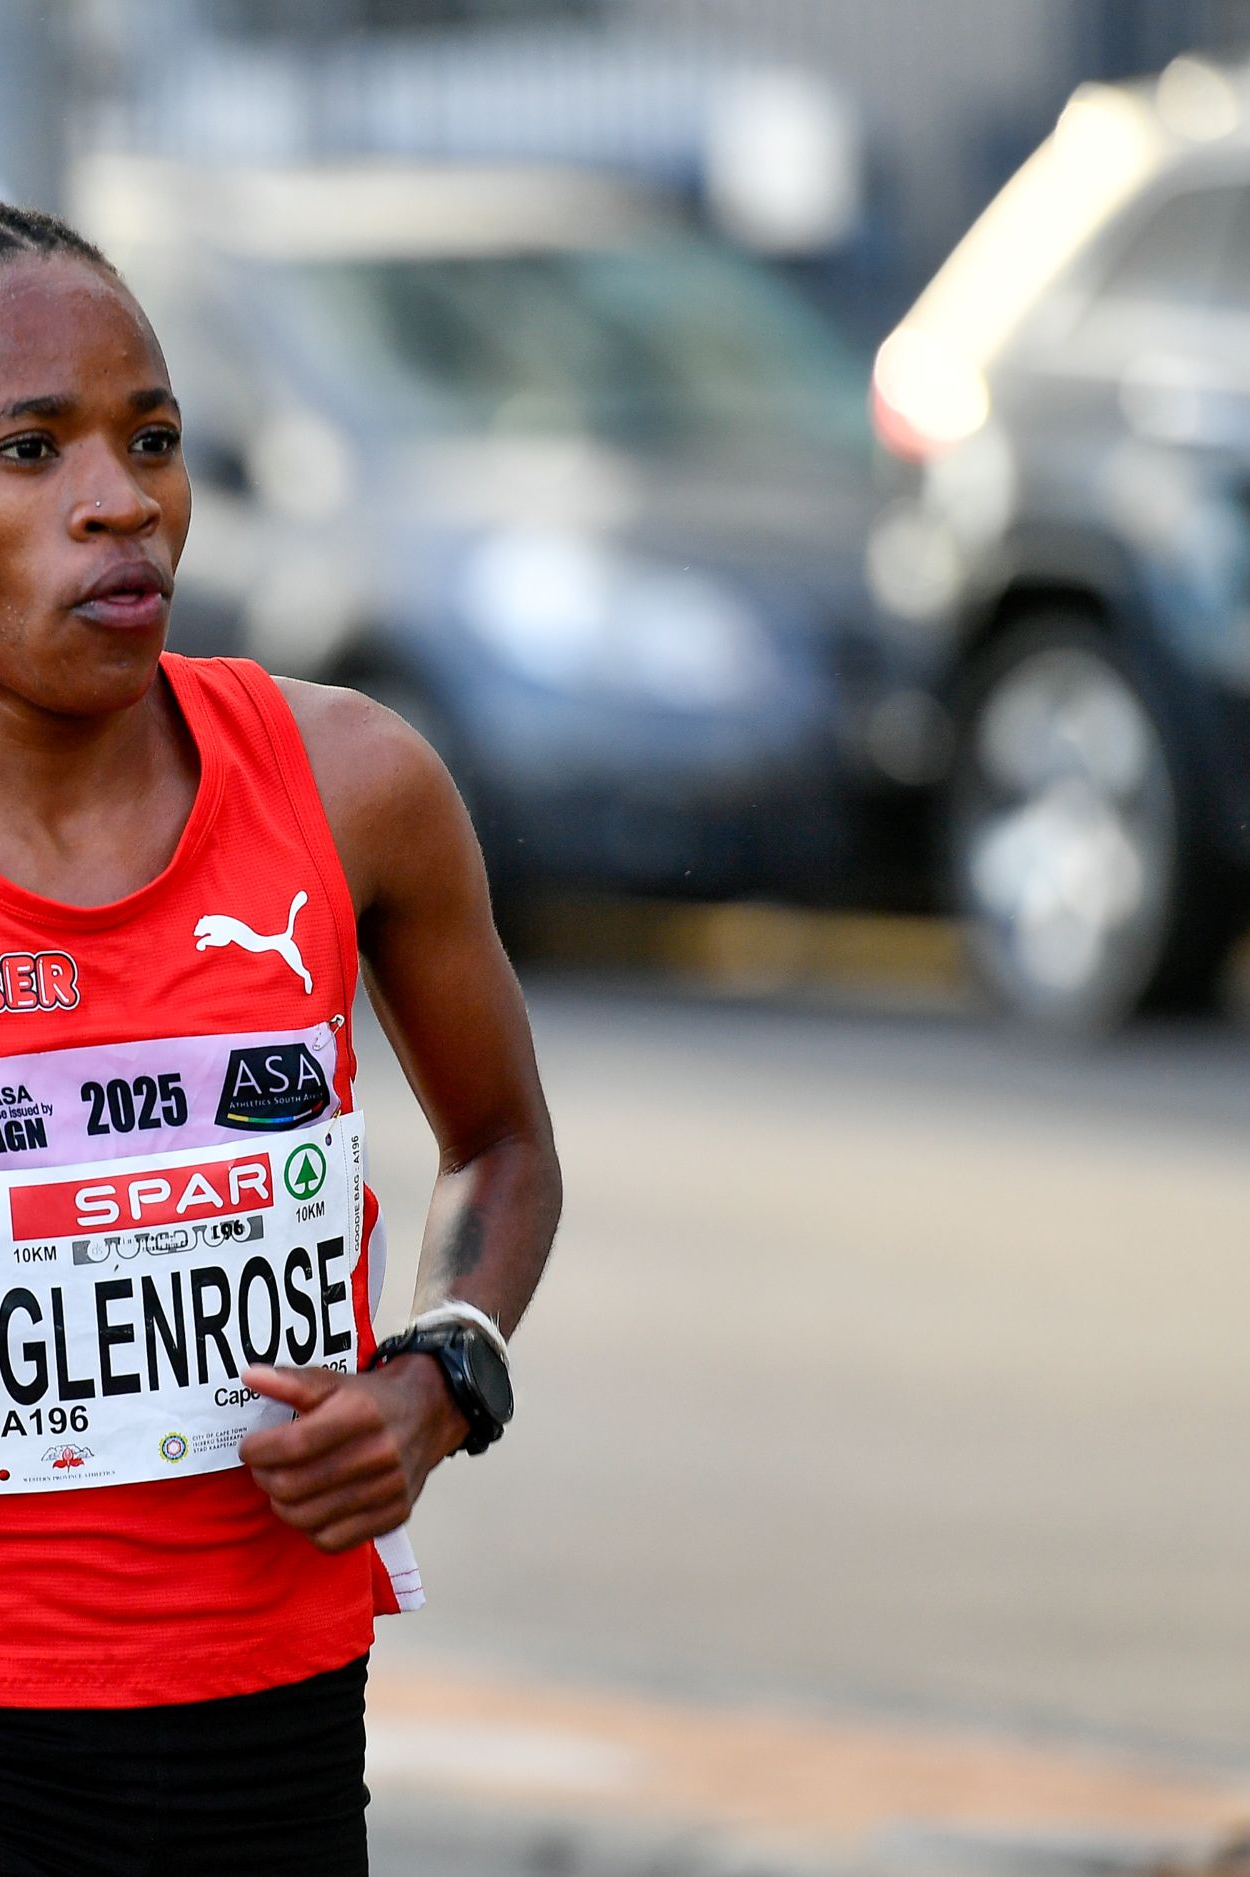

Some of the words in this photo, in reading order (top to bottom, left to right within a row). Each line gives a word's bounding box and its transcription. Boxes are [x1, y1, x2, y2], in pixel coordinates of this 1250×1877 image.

[233, 1053, 321, 1097] ASA
[9, 1104, 39, 1118] issued
[41, 1102, 53, 1116] by
[81, 1073, 188, 1136] 2025
[351, 1135, 359, 1164] A196
[75, 1163, 269, 1227] SPAR
[295, 1200, 325, 1224] 10KM
[13, 1246, 57, 1264] 10KM
[1, 1405, 89, 1438] A196
